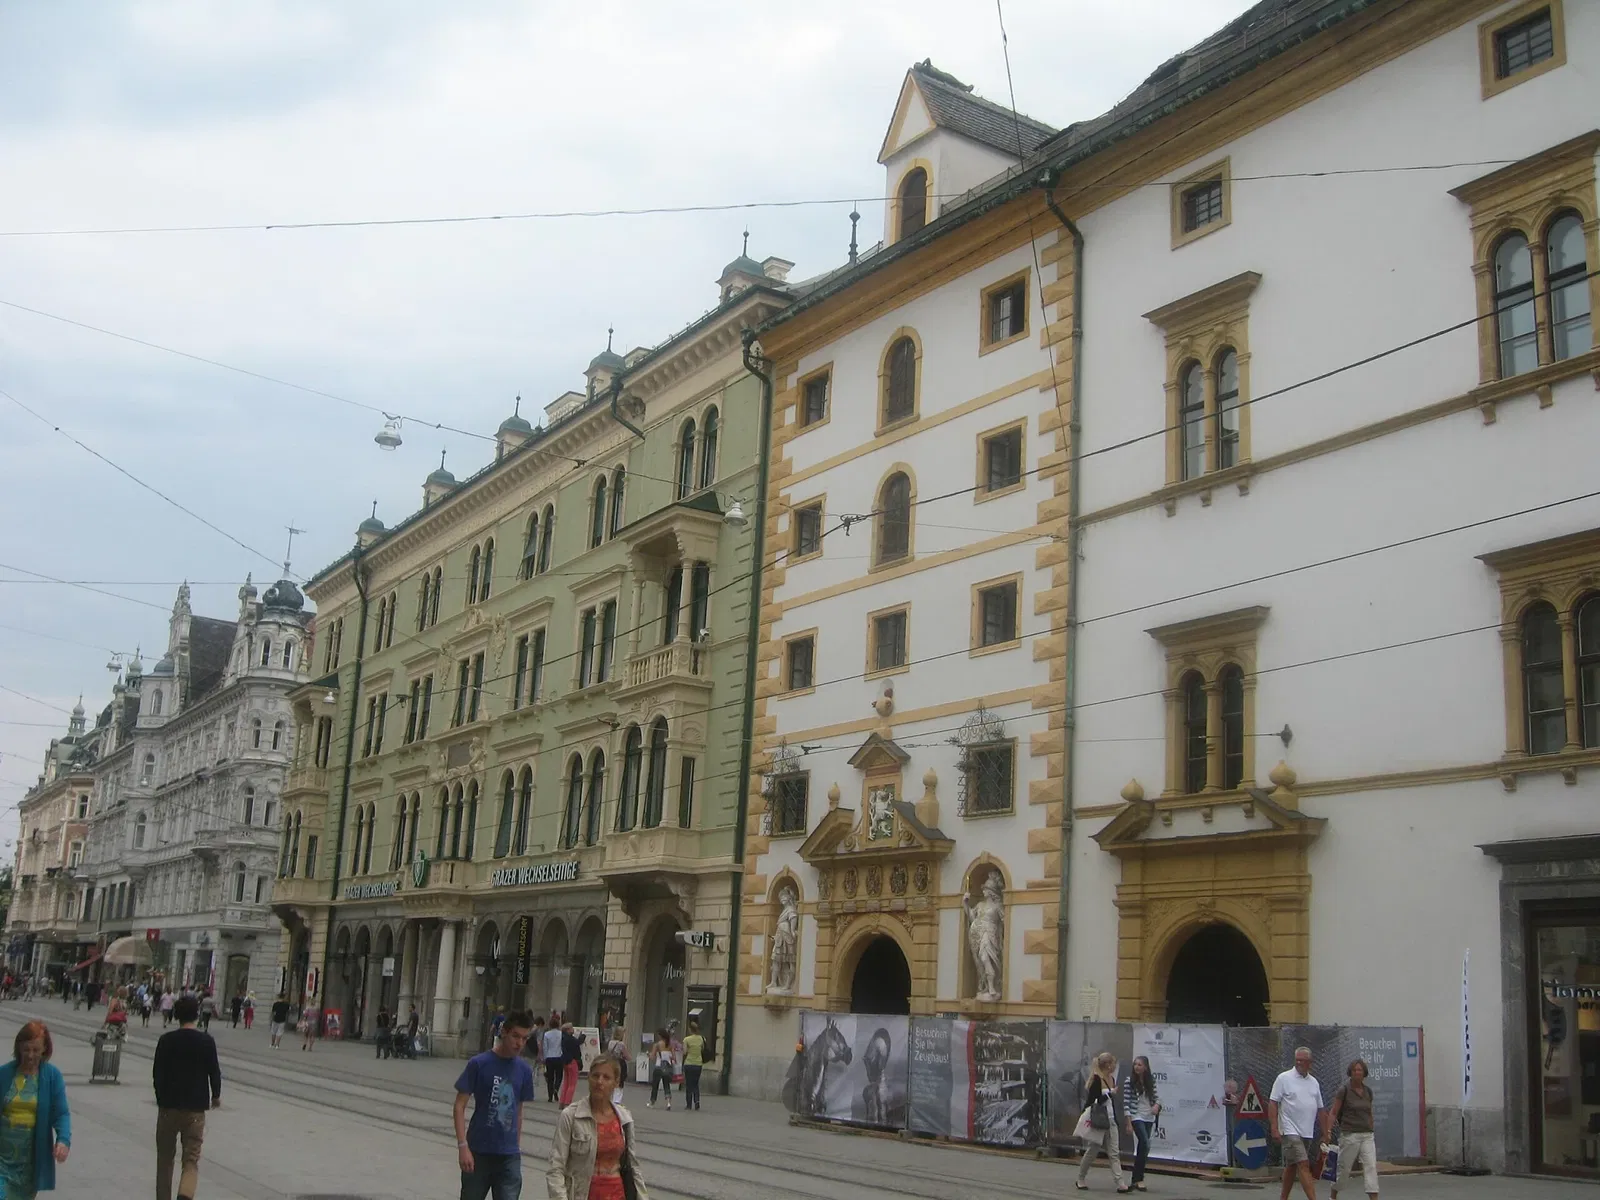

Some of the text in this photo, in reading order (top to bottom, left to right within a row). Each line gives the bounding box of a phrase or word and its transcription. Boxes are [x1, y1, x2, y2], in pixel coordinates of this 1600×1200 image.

[490, 861, 578, 887] GRAZER WECHSELSEITIGE
[915, 1026, 948, 1039] Besuchen
[914, 1038, 925, 1050] Sie
[1359, 1037, 1397, 1050] Besuchen
[914, 1050, 949, 1064] Zeughaus!
[1373, 1051, 1385, 1063] Ihr
[490, 1075, 502, 1105] STOP!
